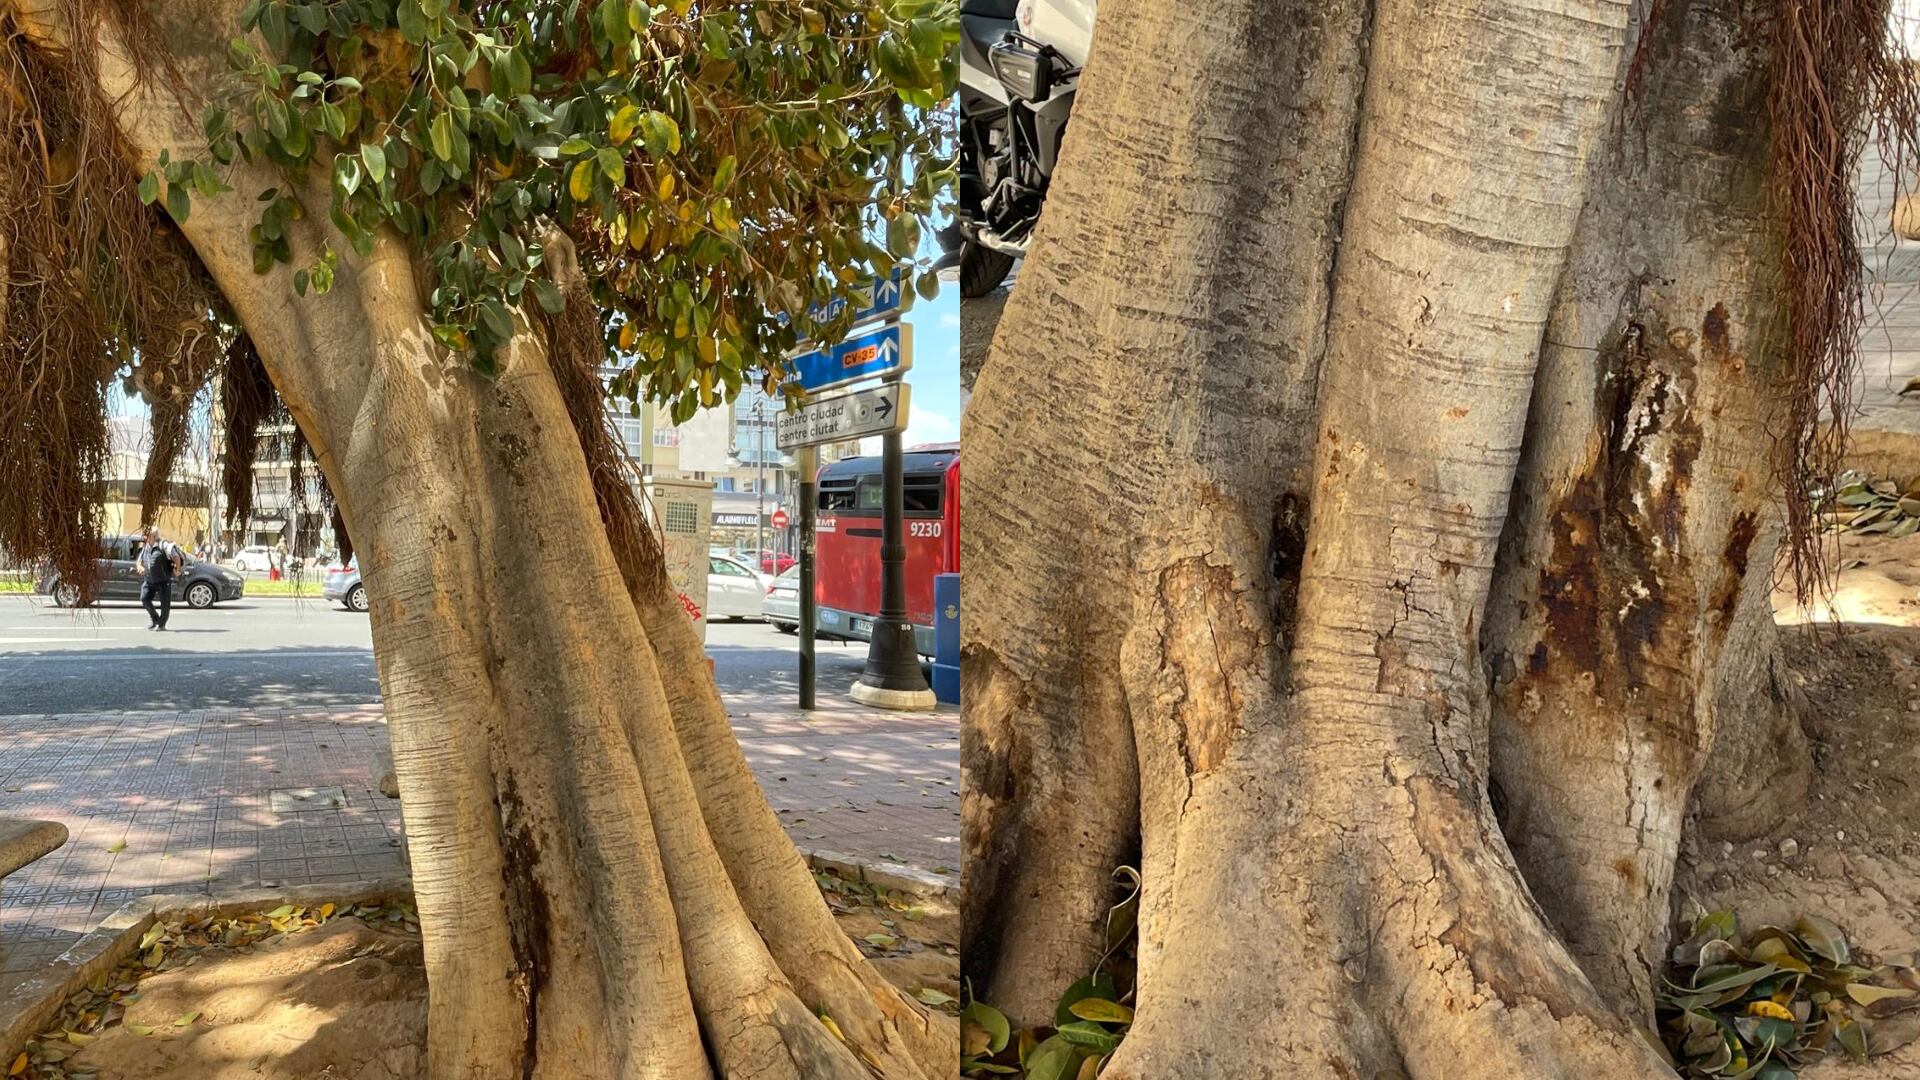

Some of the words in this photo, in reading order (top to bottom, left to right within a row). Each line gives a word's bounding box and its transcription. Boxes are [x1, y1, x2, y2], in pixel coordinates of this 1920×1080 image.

[844, 348, 876, 366] CV-35
[779, 413, 808, 428] centro
[810, 404, 844, 420] ciudad
[779, 429, 808, 443] centre
[810, 421, 839, 437] ciutat
[910, 522, 942, 538] 9230
